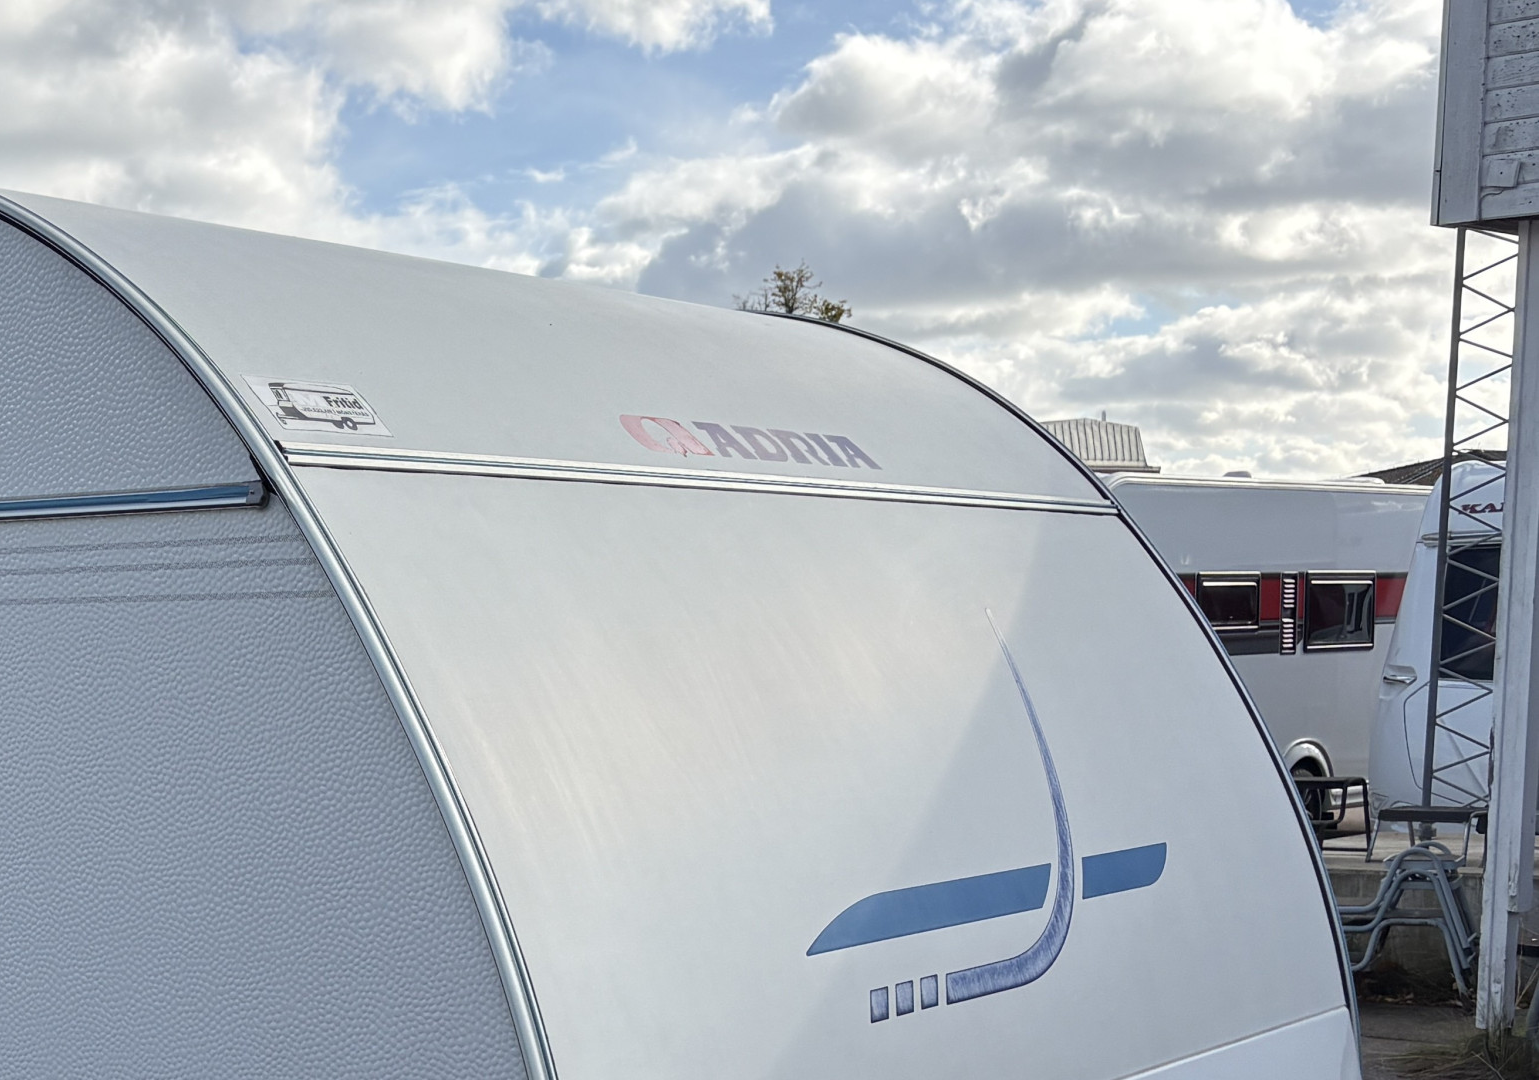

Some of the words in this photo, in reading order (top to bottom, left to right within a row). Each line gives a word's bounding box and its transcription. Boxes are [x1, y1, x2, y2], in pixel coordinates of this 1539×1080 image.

[323, 396, 364, 410] Fritid
[691, 421, 882, 470] ADRIA
[1459, 502, 1504, 514] KA
